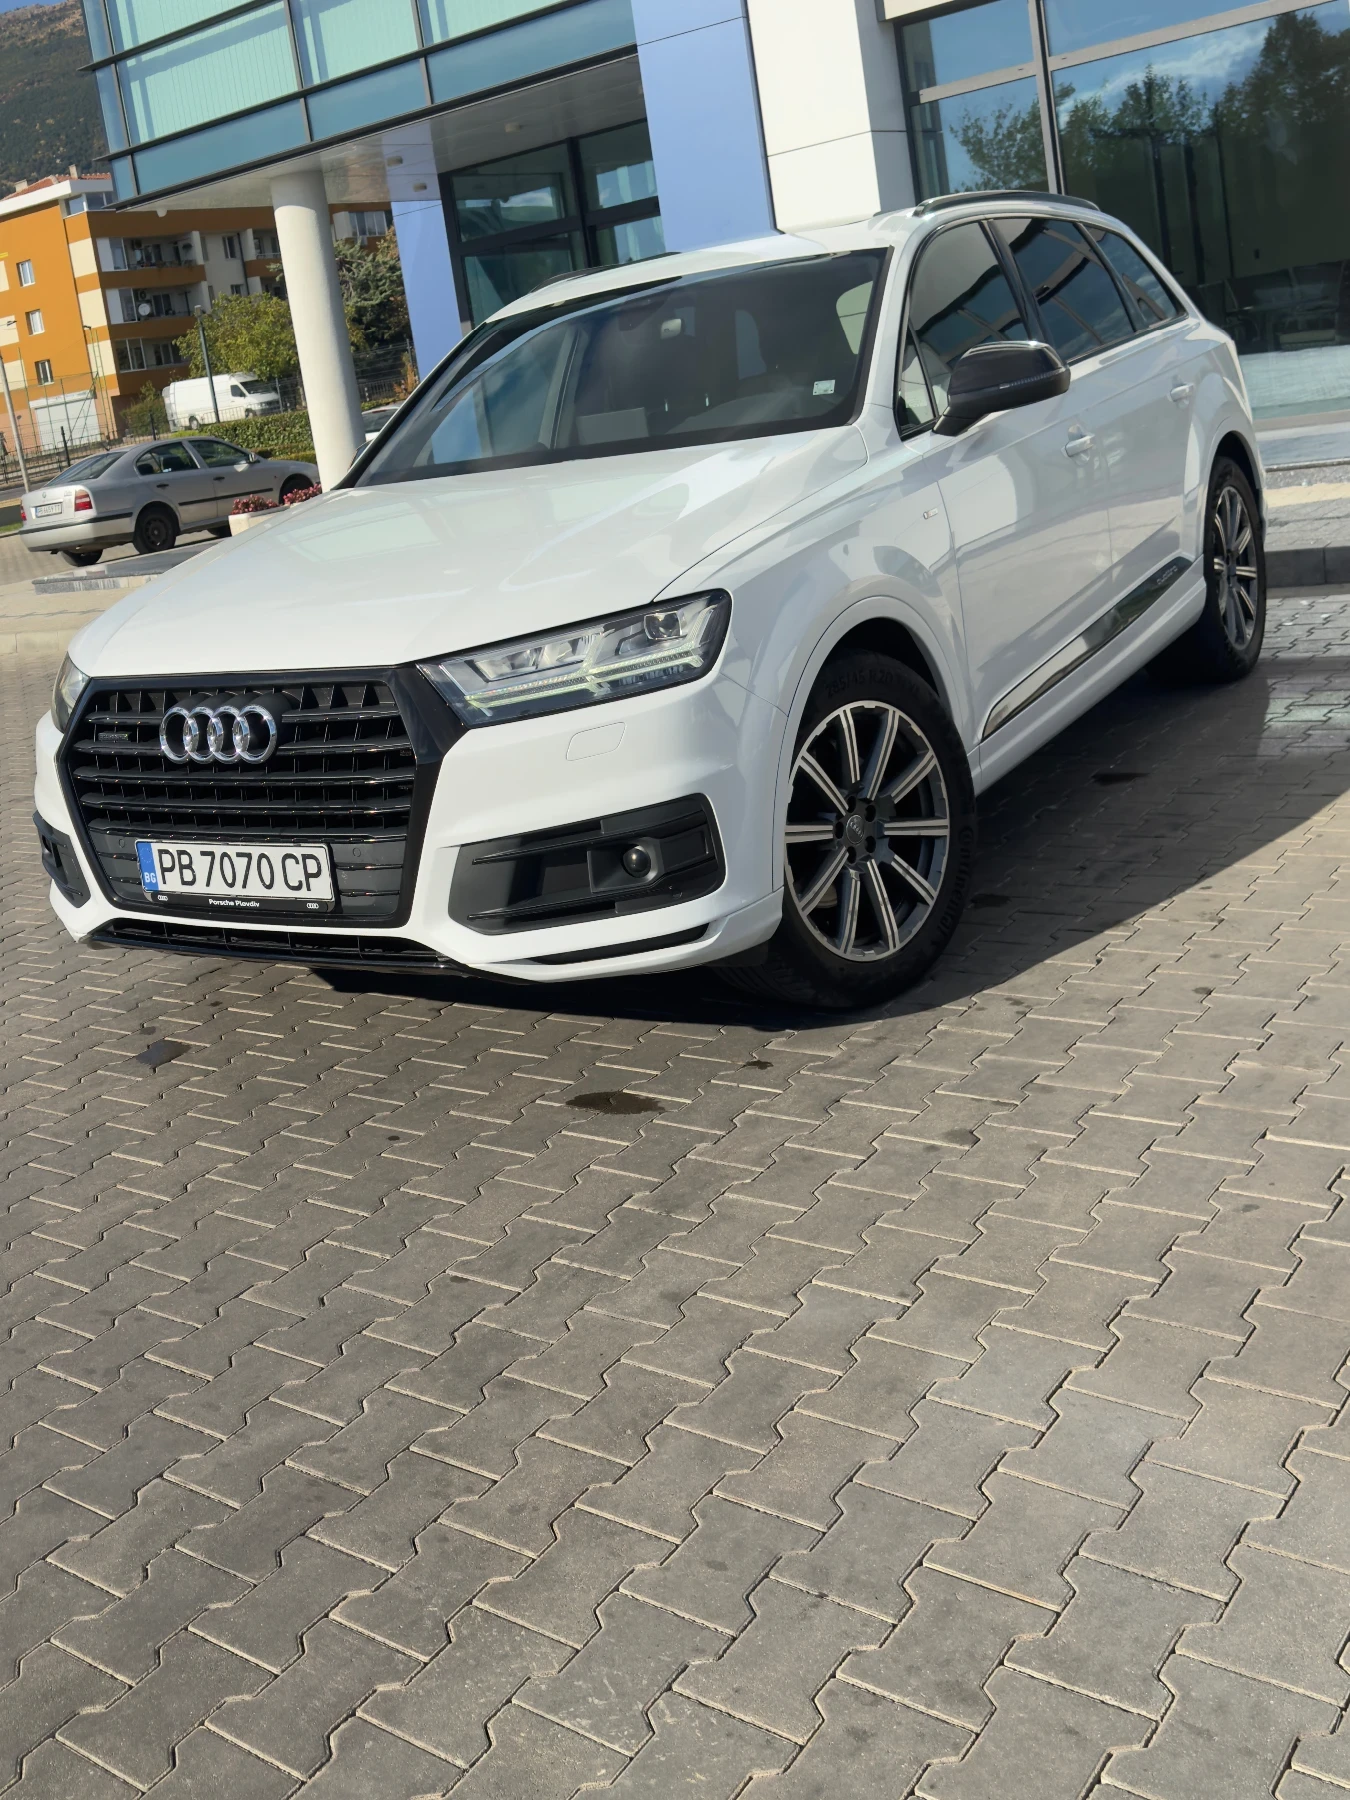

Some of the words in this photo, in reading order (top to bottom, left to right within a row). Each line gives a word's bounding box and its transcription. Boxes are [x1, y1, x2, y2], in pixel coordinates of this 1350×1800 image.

[144, 872, 156, 883] BG
[157, 849, 196, 886] PB
[200, 850, 275, 890] 7070
[281, 853, 322, 891] CP
